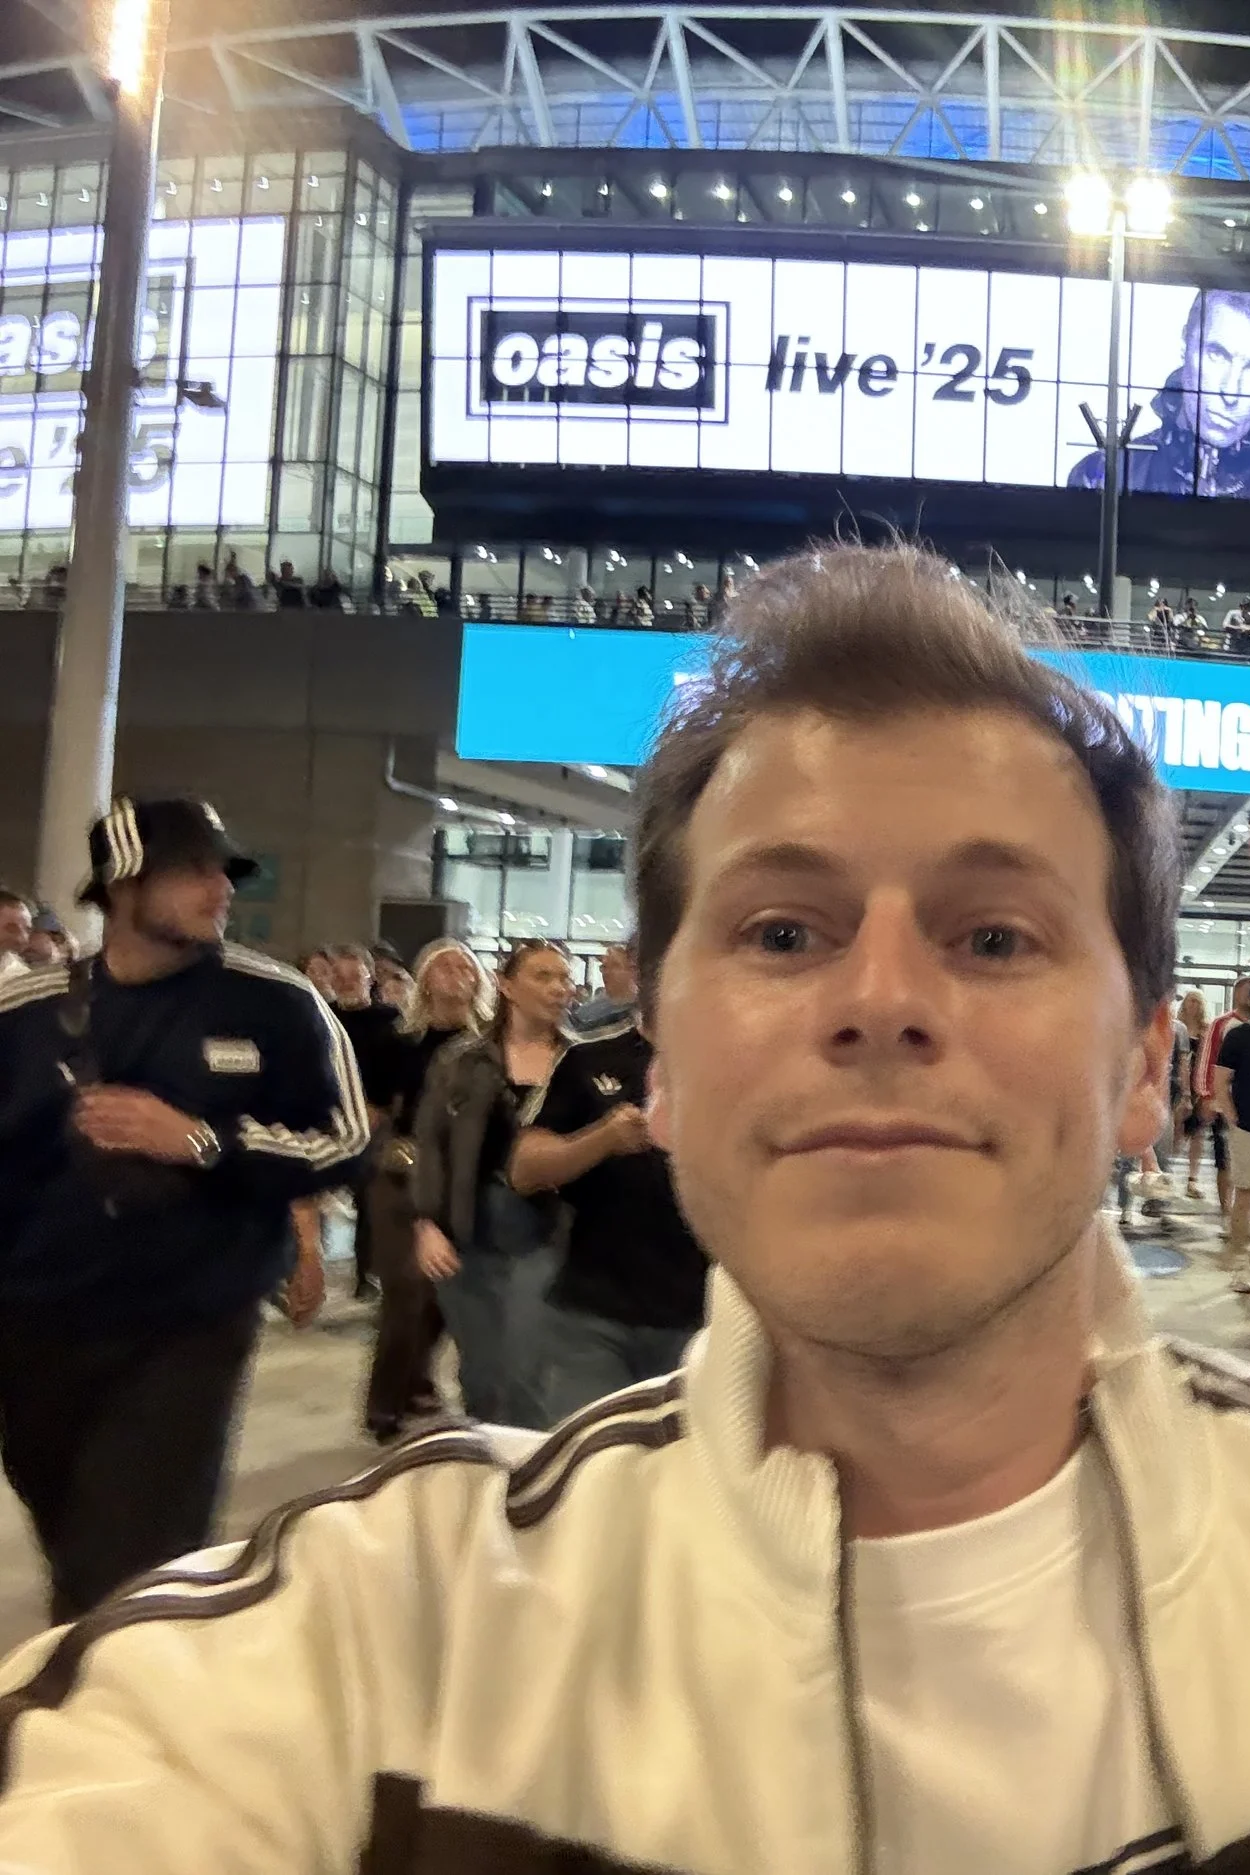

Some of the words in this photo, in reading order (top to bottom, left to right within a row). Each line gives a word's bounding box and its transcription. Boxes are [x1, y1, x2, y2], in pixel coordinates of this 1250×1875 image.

[492, 321, 706, 391] oasis
[764, 334, 898, 398] live
[920, 342, 1035, 406] '25
[50, 426, 178, 493] '5
